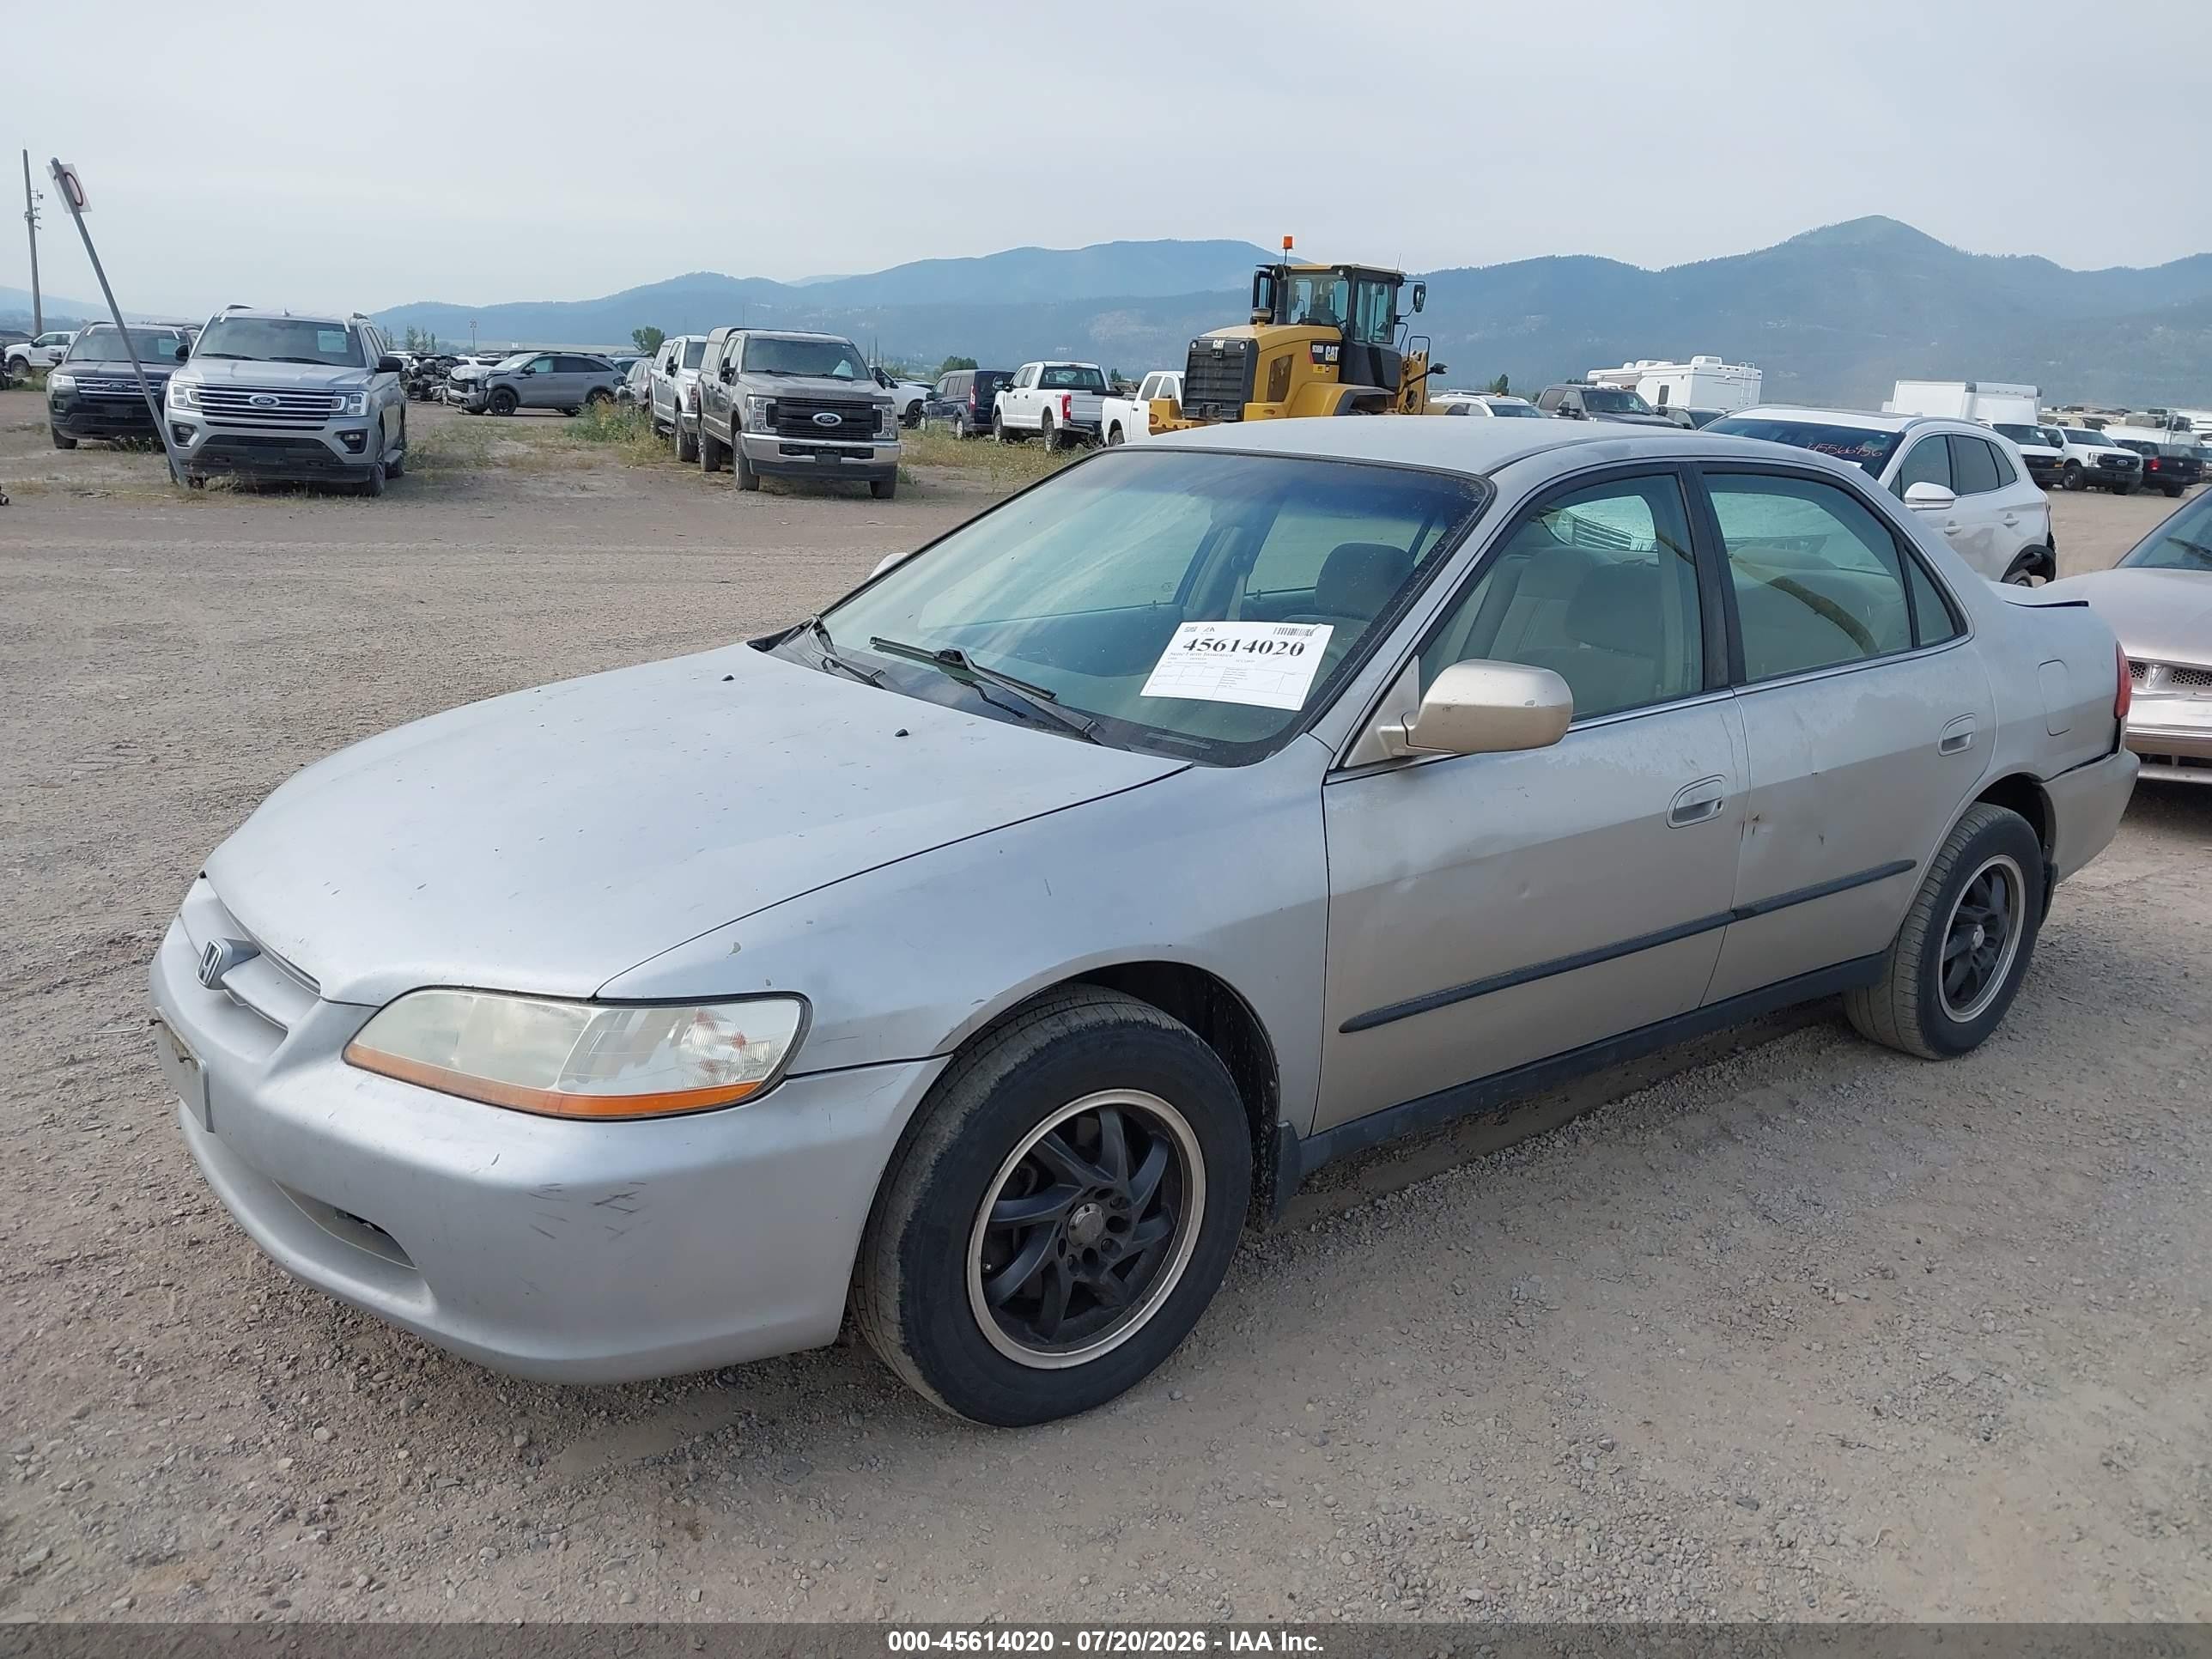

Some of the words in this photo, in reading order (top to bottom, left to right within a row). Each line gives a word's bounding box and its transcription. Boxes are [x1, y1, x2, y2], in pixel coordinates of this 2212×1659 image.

[1212, 339, 1225, 349] CAT
[1325, 345, 1340, 362] CAT
[1182, 637, 1305, 657] 45614020
